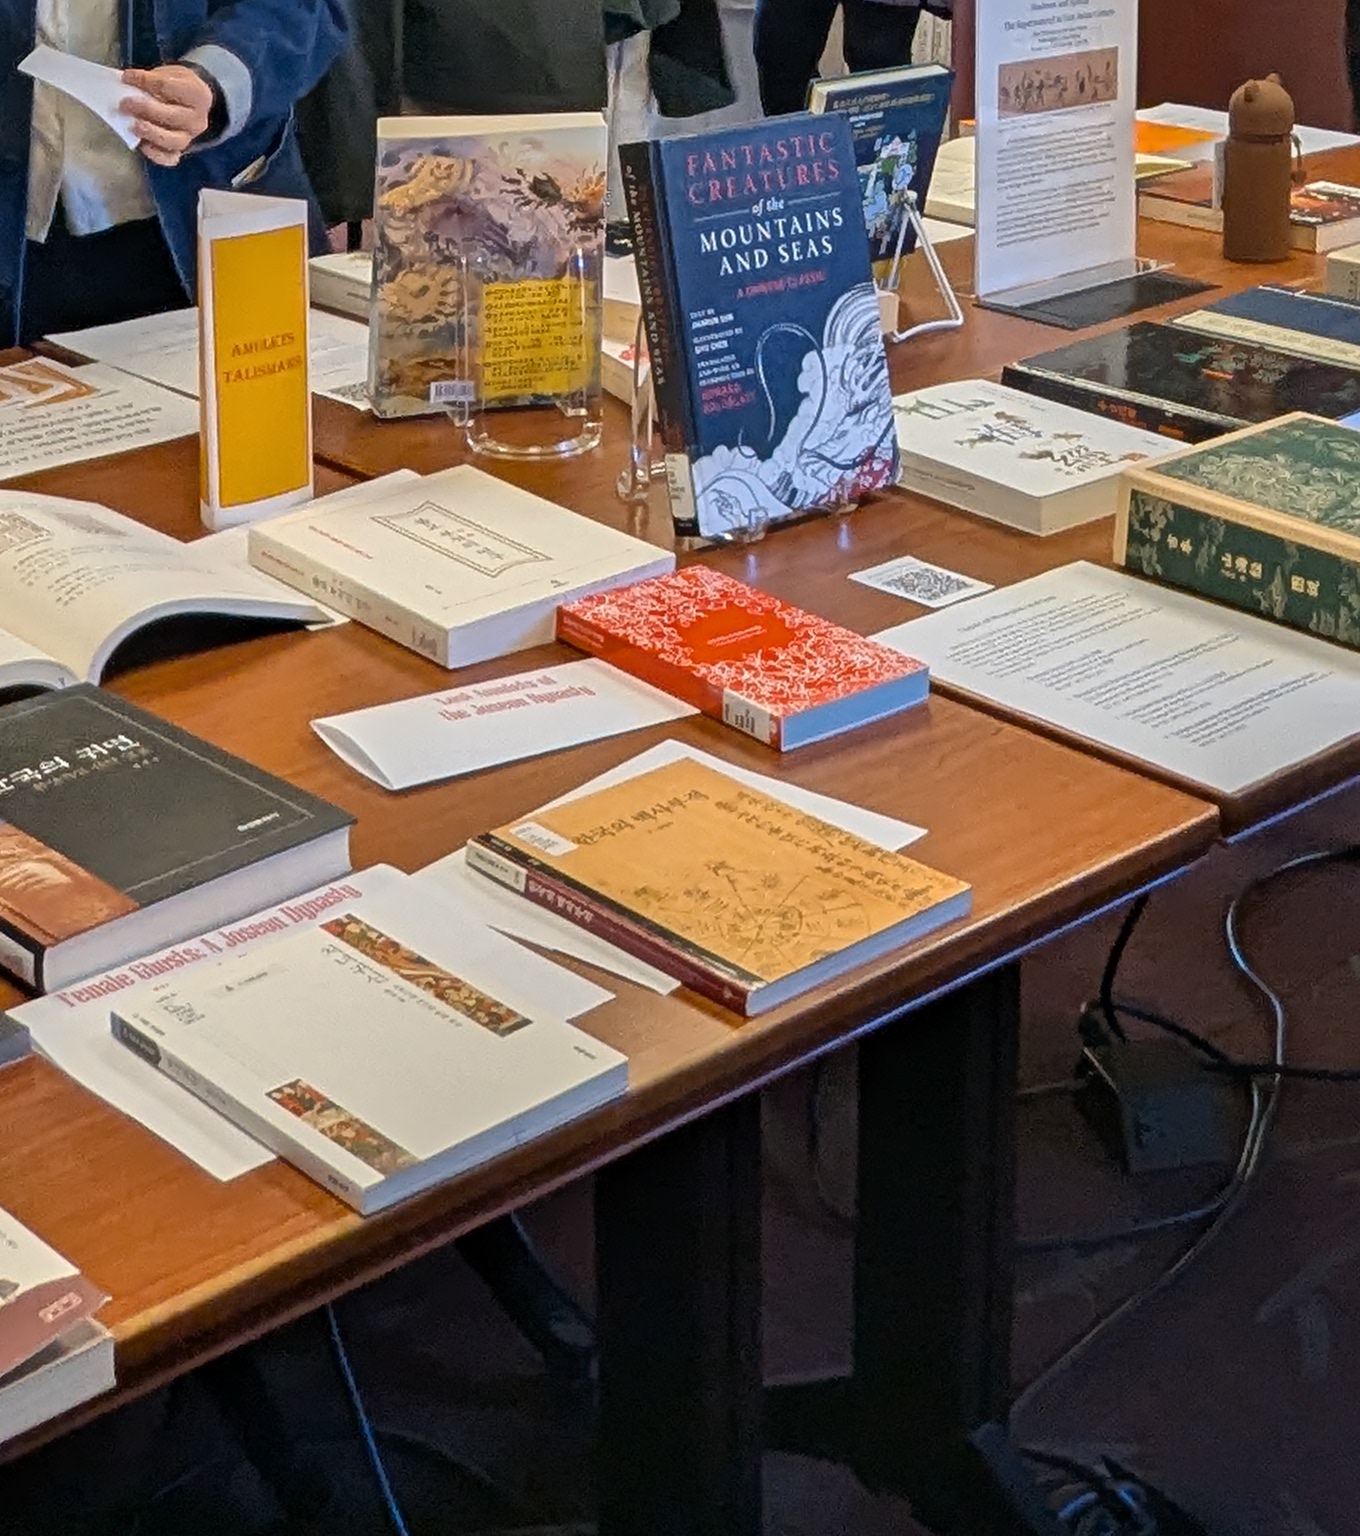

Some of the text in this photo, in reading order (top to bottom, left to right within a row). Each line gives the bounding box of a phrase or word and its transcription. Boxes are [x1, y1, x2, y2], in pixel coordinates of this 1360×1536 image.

[686, 131, 836, 177] FANTASTIC
[688, 158, 841, 205] CREATURES
[751, 196, 786, 217] of the
[700, 206, 844, 254] MOUNTAINS
[633, 210, 654, 306] MOUNTAINS
[719, 235, 834, 278] AND SEAS
[222, 354, 303, 384] TALISMANS
[56, 970, 136, 1009] Female
[199, 936, 224, 955] A
[224, 914, 290, 949] Joseon
[278, 883, 364, 925] Dynasty
